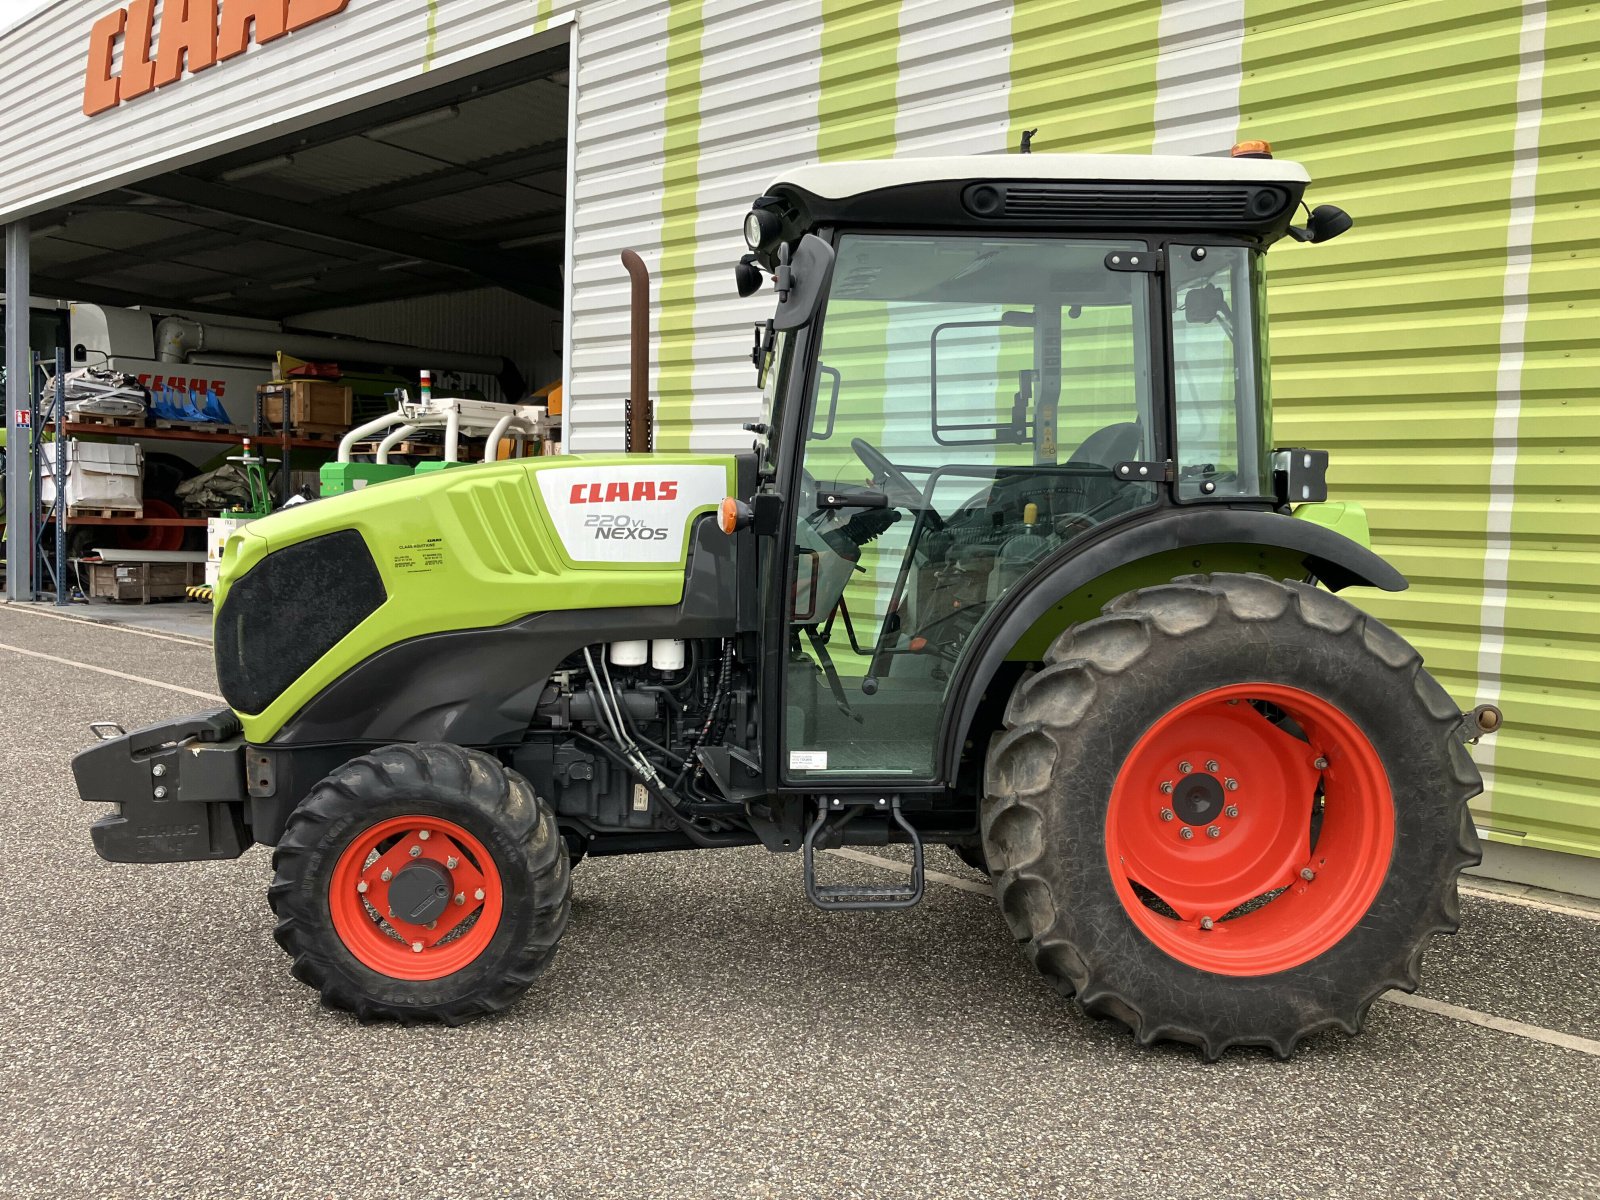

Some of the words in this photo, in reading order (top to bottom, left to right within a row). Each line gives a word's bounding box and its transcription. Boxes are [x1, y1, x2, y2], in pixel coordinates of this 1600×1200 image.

[83, 0, 349, 117] CLAA
[569, 481, 678, 504] CLAAS
[584, 514, 631, 527] 220
[594, 527, 669, 540] NEXOS
